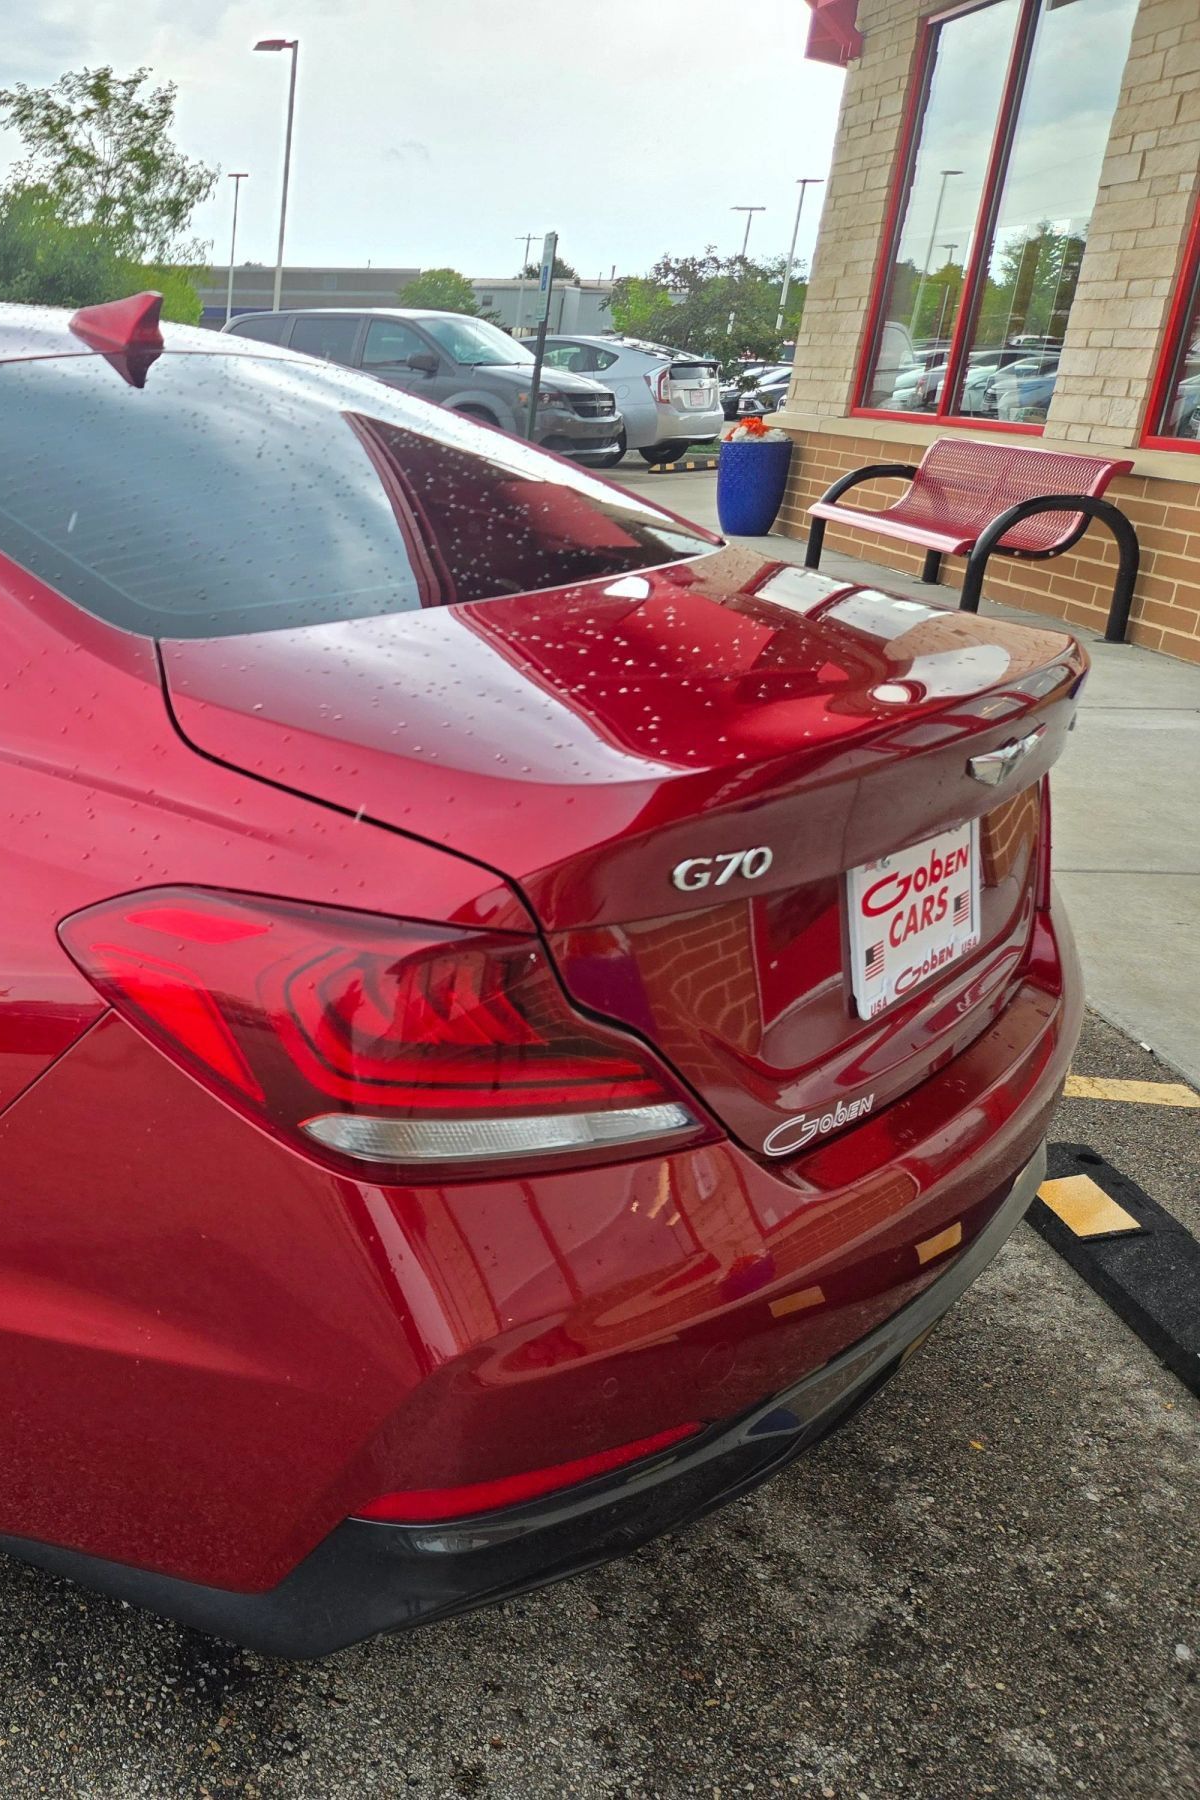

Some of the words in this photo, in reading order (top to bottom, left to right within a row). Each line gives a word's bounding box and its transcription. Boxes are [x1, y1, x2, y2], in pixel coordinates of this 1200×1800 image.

[672, 846, 773, 891] G70
[889, 885, 949, 948] CARS
[961, 936, 977, 954] USA
[870, 996, 887, 1017] USA
